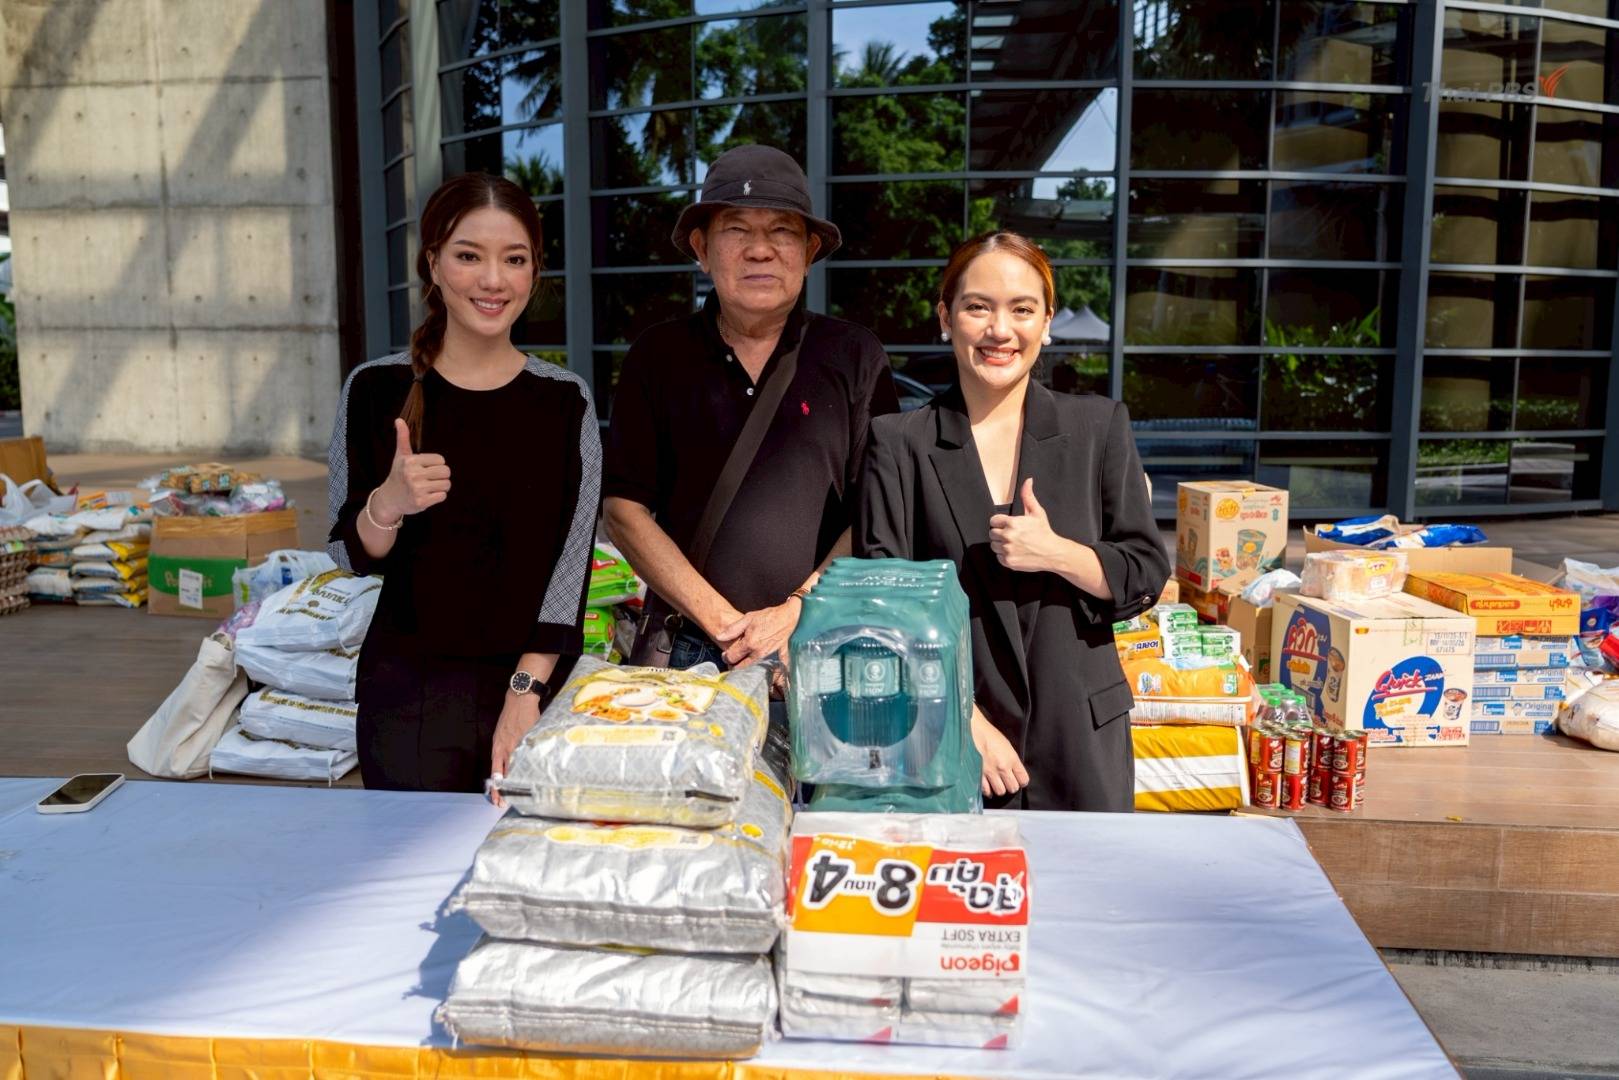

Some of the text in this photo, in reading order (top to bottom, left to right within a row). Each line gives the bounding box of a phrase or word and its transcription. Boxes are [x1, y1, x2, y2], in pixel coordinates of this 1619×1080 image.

[1374, 668, 1423, 697] Quick
[1524, 702, 1554, 711] Original
[808, 855, 848, 904] 4
[876, 862, 917, 909] 8
[929, 860, 981, 894] คุ้ม
[968, 876, 1021, 912] สุด
[941, 928, 1021, 943] EXTRA SOFT
[940, 953, 1020, 976] pigeon
